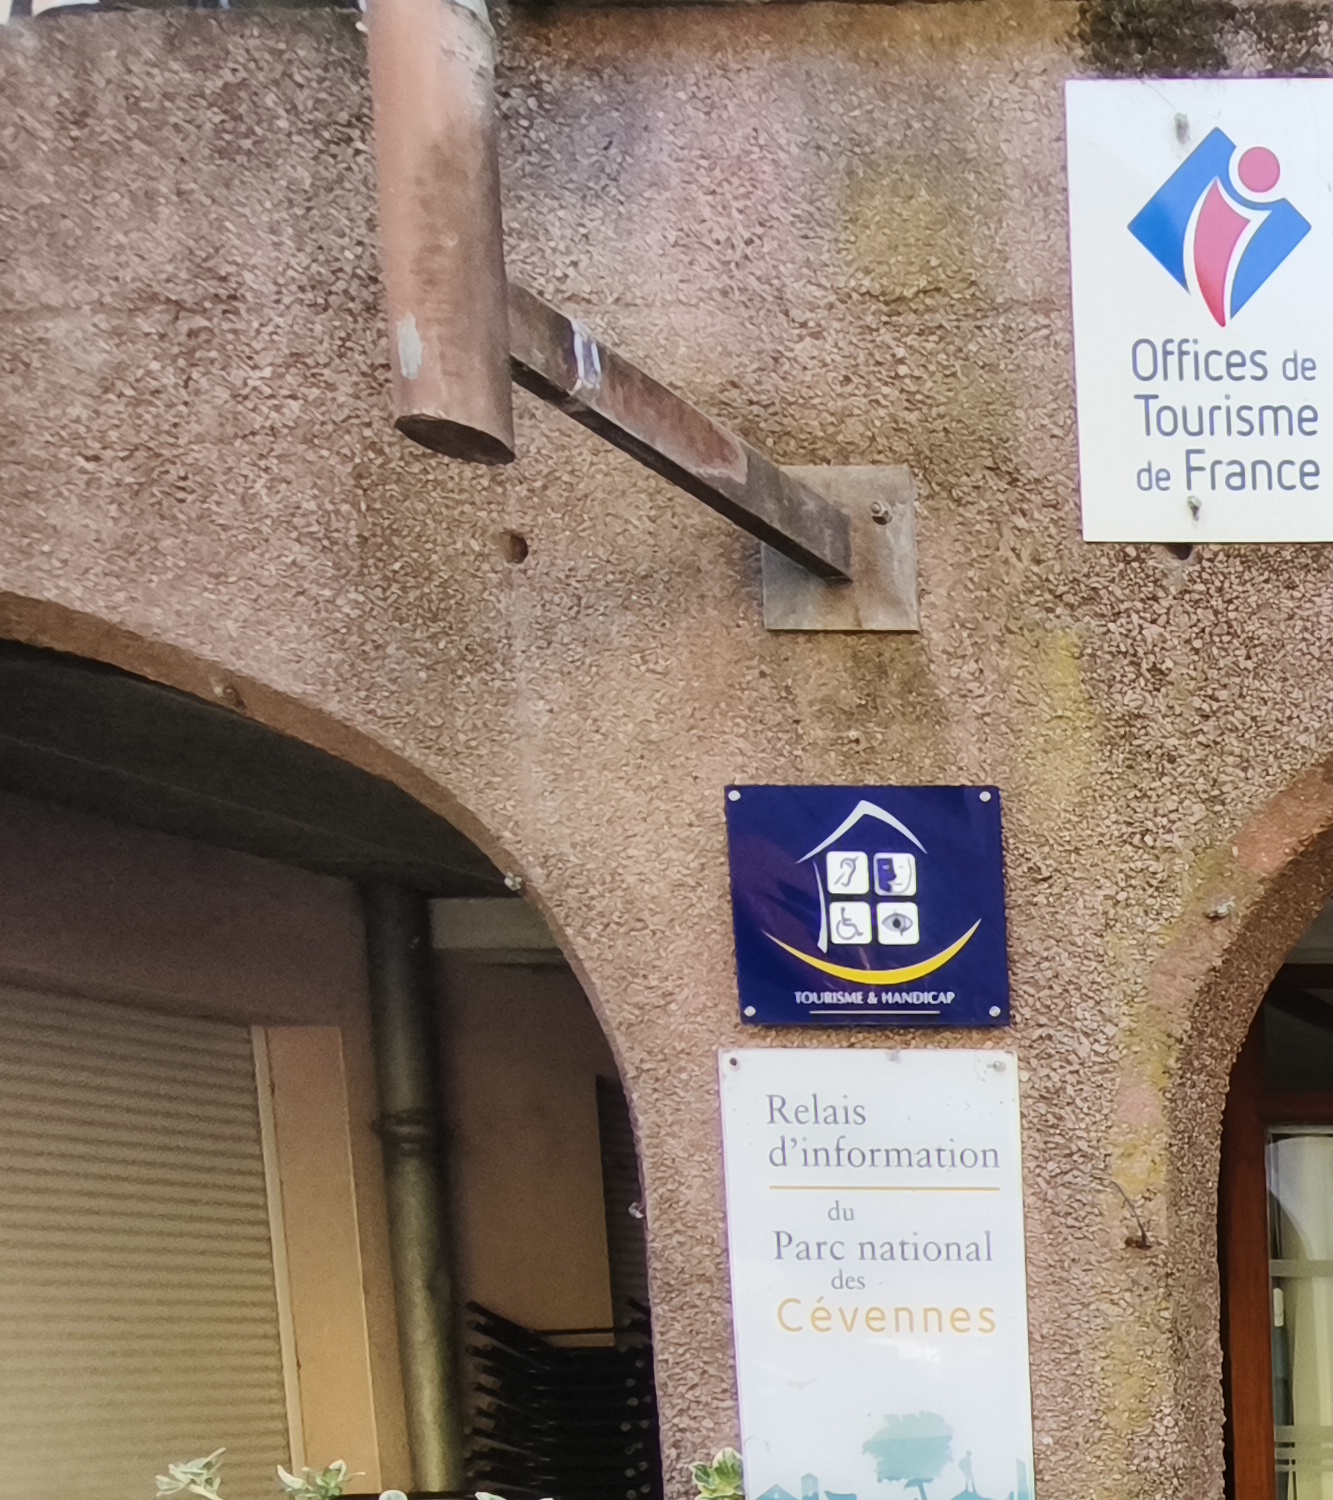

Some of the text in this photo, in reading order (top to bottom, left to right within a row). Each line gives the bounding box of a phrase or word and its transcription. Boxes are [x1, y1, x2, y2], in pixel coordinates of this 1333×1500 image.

[1131, 338, 1318, 383] Offices de
[1133, 393, 1320, 437] Tourisme
[1136, 449, 1321, 492] de France
[794, 991, 956, 1005] TOURISME & HANDICAP
[765, 1093, 867, 1126] Relais
[768, 1134, 1001, 1168] d’information
[827, 1199, 856, 1222] du
[773, 1230, 994, 1262] Parc national
[831, 1268, 866, 1290] des
[777, 1295, 997, 1335] Cévennes
